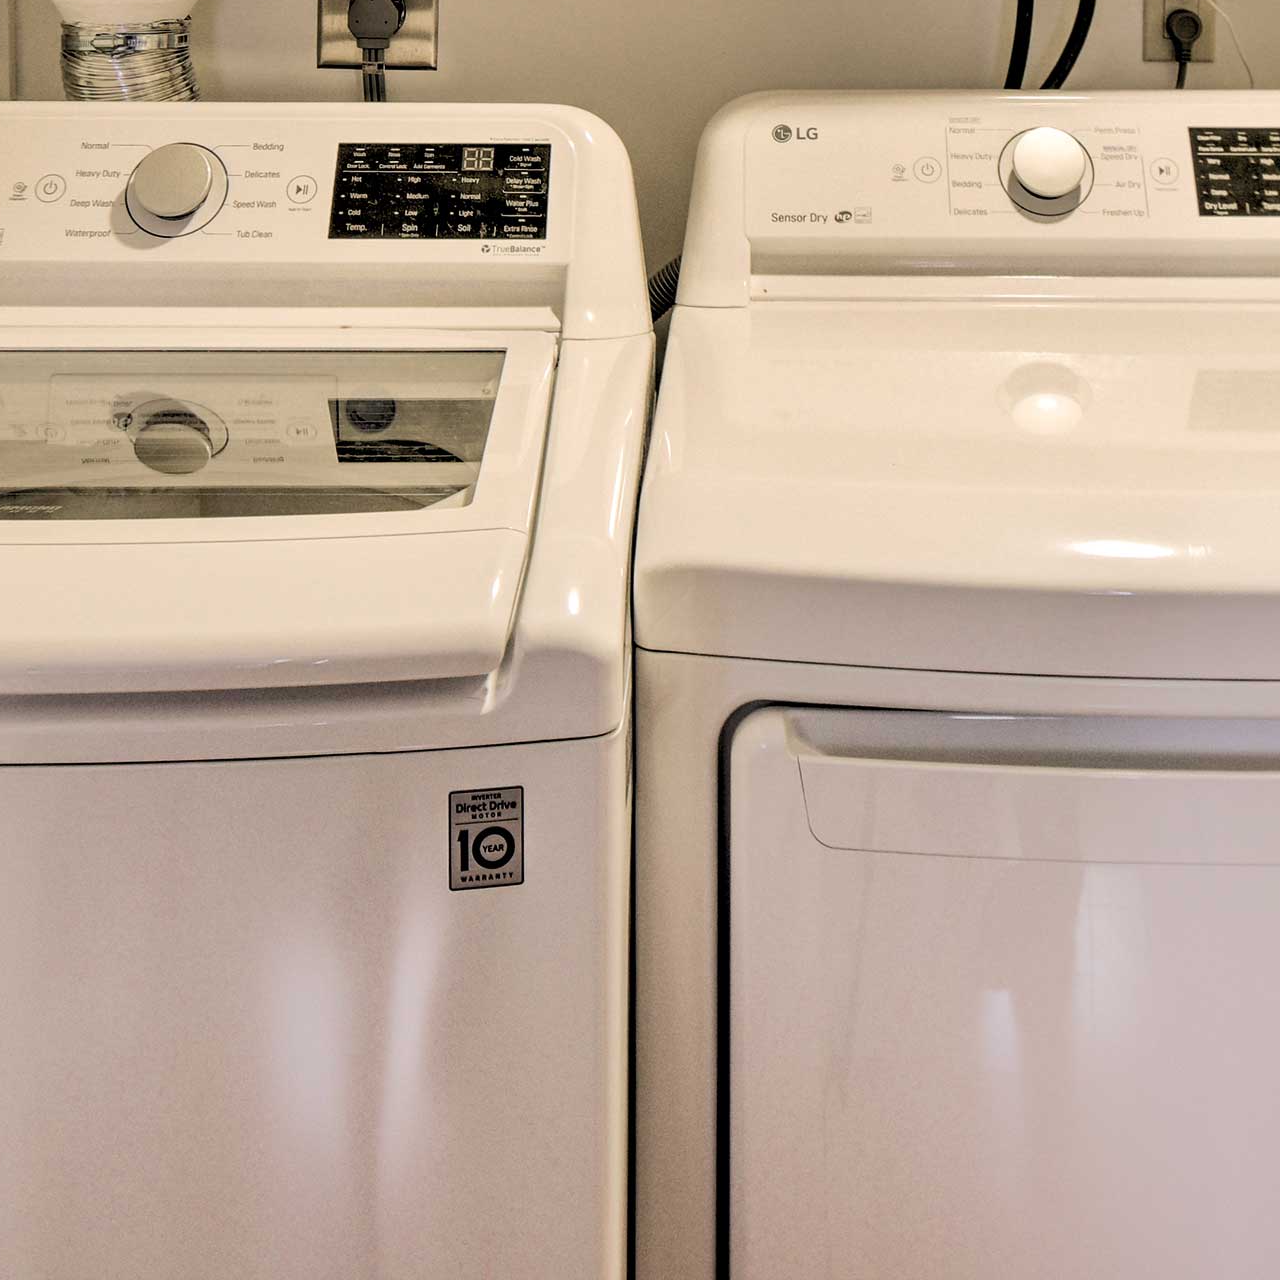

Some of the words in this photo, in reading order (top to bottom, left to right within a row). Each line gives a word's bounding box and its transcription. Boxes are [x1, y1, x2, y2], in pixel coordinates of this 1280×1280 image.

[796, 127, 819, 140] LG
[80, 142, 110, 150] Normal
[252, 143, 285, 152] Bedding
[950, 152, 974, 161] Heavy
[975, 152, 992, 161] Duty
[1100, 153, 1124, 161] Speed
[75, 170, 101, 178] Heavy
[102, 170, 121, 178] Duty
[244, 170, 281, 178] Delicates
[407, 176, 421, 184] High
[461, 176, 480, 184] Heavy
[505, 177, 523, 186] Delay
[523, 177, 541, 185] Wash
[952, 180, 983, 189] Bedding
[1127, 181, 1141, 189] Dry
[406, 192, 430, 200] Medium
[460, 192, 481, 200] Normal
[70, 199, 91, 208] Deep
[91, 199, 114, 207] Wash
[232, 200, 255, 209] Speed
[256, 200, 277, 208] Wash
[505, 199, 525, 207] Water
[525, 199, 539, 207] Plus
[1204, 202, 1218, 210] Dry
[404, 209, 418, 217] Low
[458, 210, 474, 218] Light
[953, 208, 988, 216] Delicates
[1102, 209, 1132, 217] Freshen
[1133, 209, 1145, 217] Up
[771, 212, 807, 223] Sensor
[809, 212, 829, 225] Dry
[345, 222, 368, 232] Temp.
[401, 223, 418, 233] Spin
[457, 223, 471, 232] Soil
[503, 225, 520, 233] Extra
[521, 225, 538, 233] Rinse
[64, 229, 112, 238] Waterproof
[236, 230, 250, 238] Tub
[251, 230, 273, 238] Clean
[455, 802, 487, 813] Direct
[489, 800, 517, 810] Drive
[457, 826, 516, 872] 10
[482, 843, 505, 853] YEAR
[460, 872, 514, 883] WARRANTY
